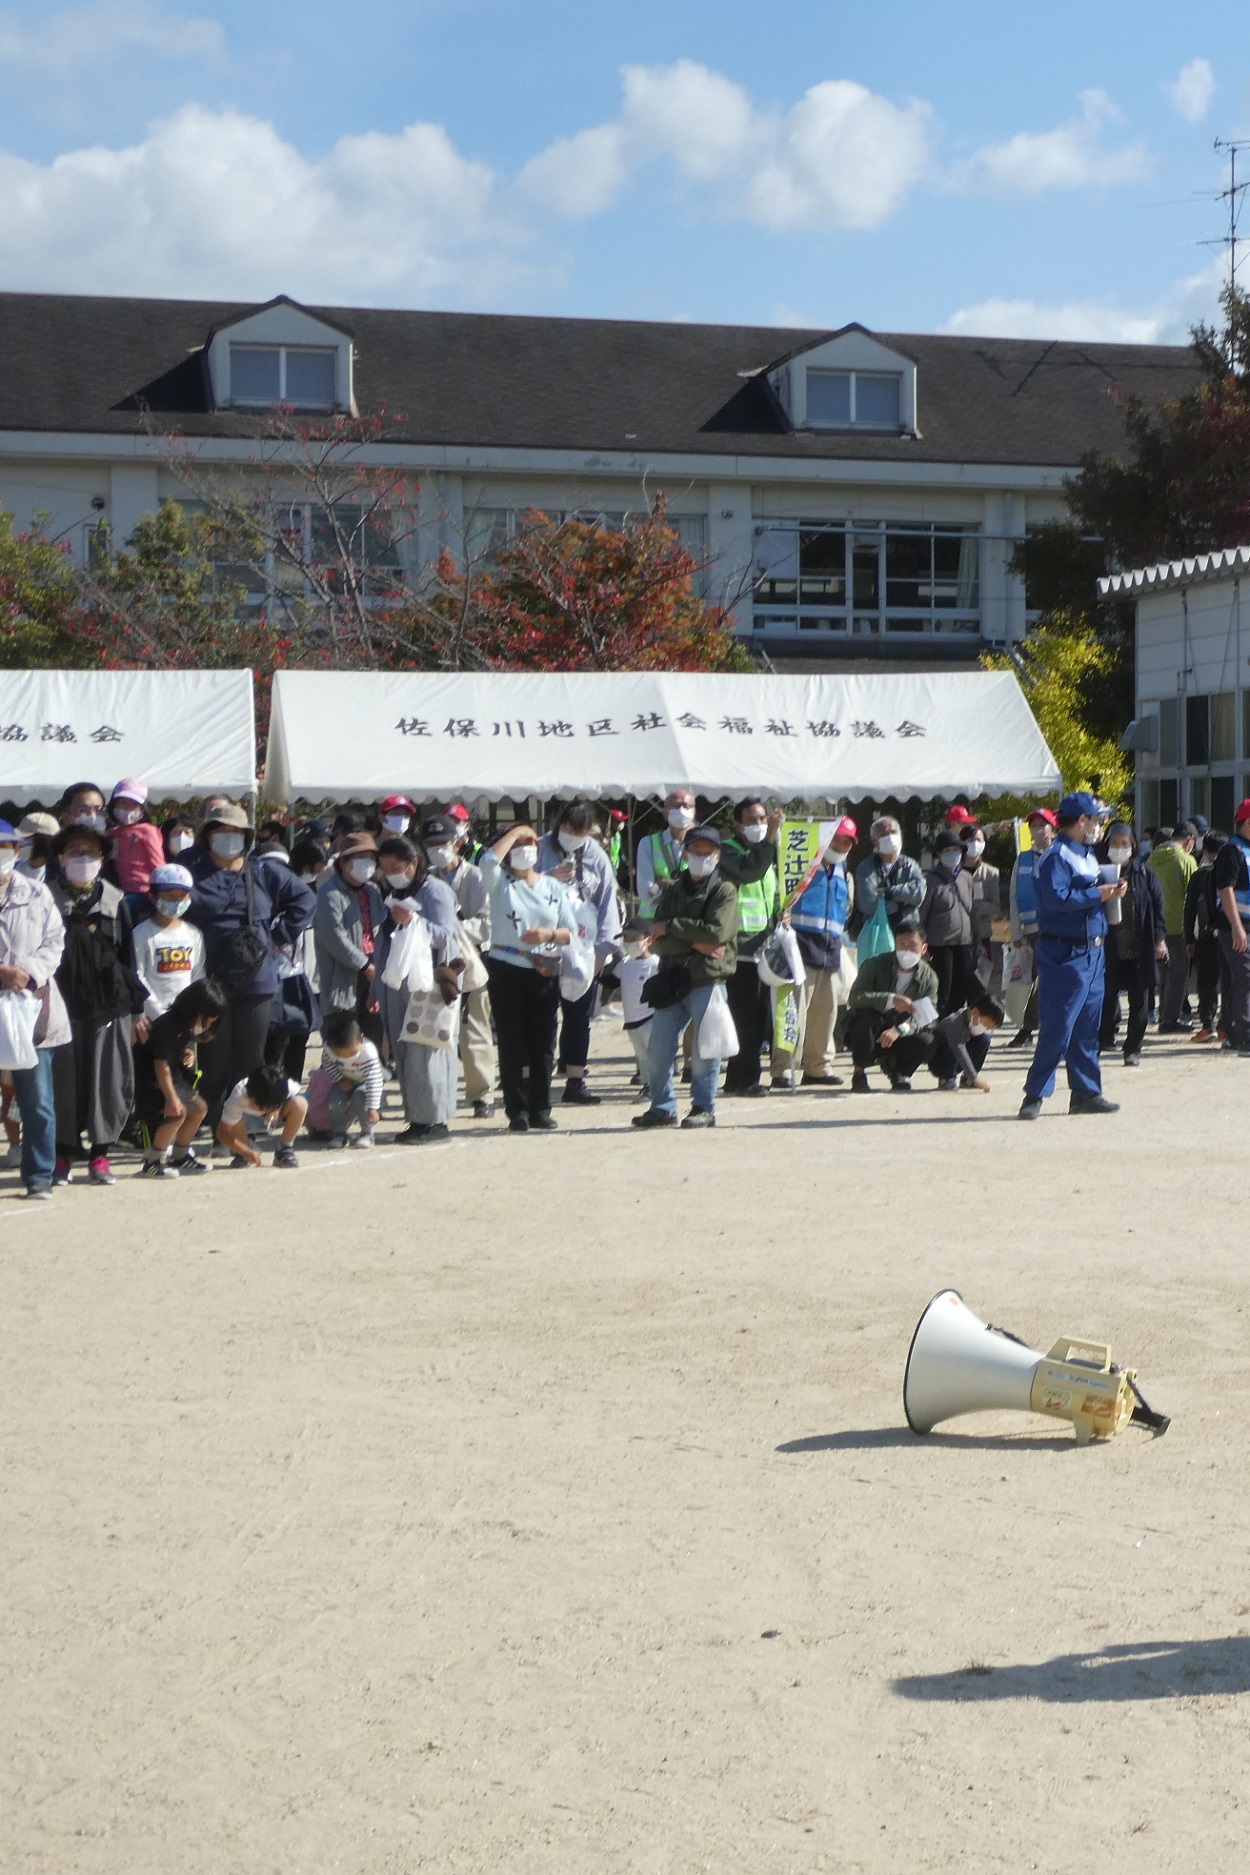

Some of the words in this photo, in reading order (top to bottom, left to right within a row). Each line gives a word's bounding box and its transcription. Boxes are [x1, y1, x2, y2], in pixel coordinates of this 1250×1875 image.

[394, 711, 926, 739] 佐保川地区社会福祉協議会
[156, 945, 192, 963] TOY
